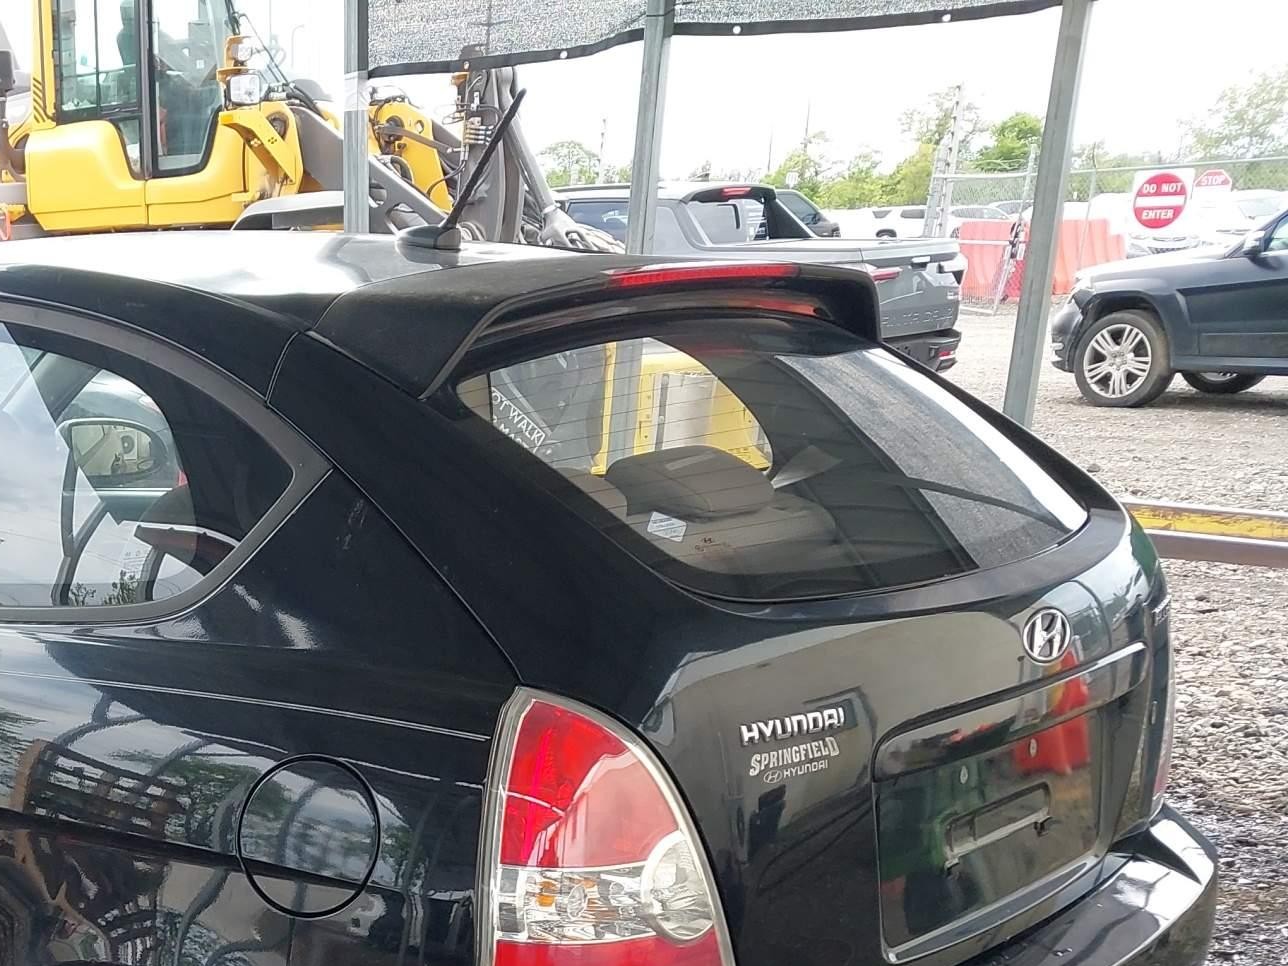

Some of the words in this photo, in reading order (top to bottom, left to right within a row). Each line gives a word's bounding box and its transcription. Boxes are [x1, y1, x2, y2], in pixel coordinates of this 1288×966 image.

[1143, 183, 1157, 193] DO
[1161, 182, 1183, 193] NOT
[1201, 175, 1225, 186] STOP
[1142, 209, 1174, 219] ENTER
[508, 405, 543, 447] WALK
[740, 707, 845, 745] HYUNDAI
[749, 736, 841, 777] SPRINGFIELD
[783, 759, 829, 778] HYUNDAI
